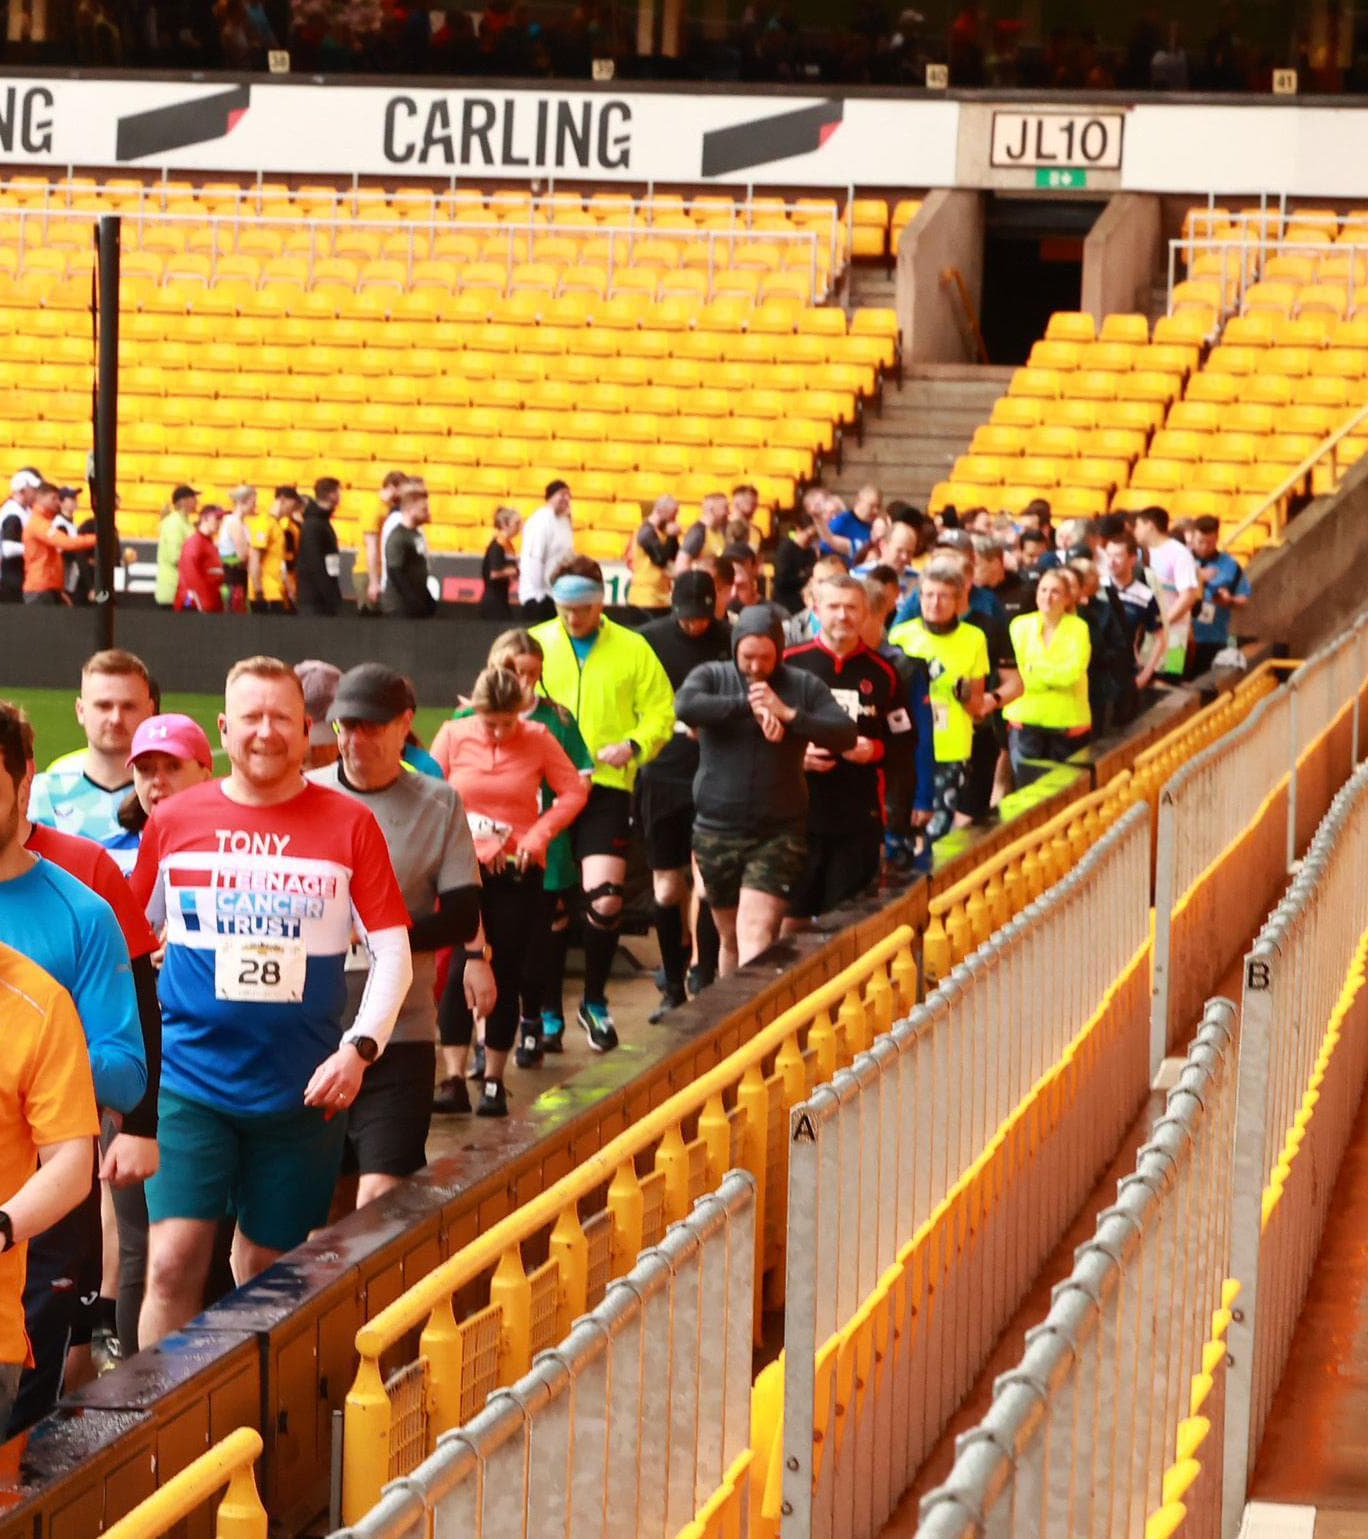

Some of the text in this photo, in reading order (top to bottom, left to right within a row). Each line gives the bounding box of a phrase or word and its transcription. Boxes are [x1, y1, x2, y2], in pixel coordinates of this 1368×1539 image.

[384, 96, 632, 168] CARLING
[1006, 119, 1108, 162] JL10
[215, 829, 291, 857] TONY
[218, 867, 337, 898] TEENAGE
[217, 891, 325, 918] CANCER
[217, 914, 301, 938] TRUST
[238, 959, 281, 985] 28
[1248, 962, 1270, 990] B
[793, 1114, 816, 1141] A
